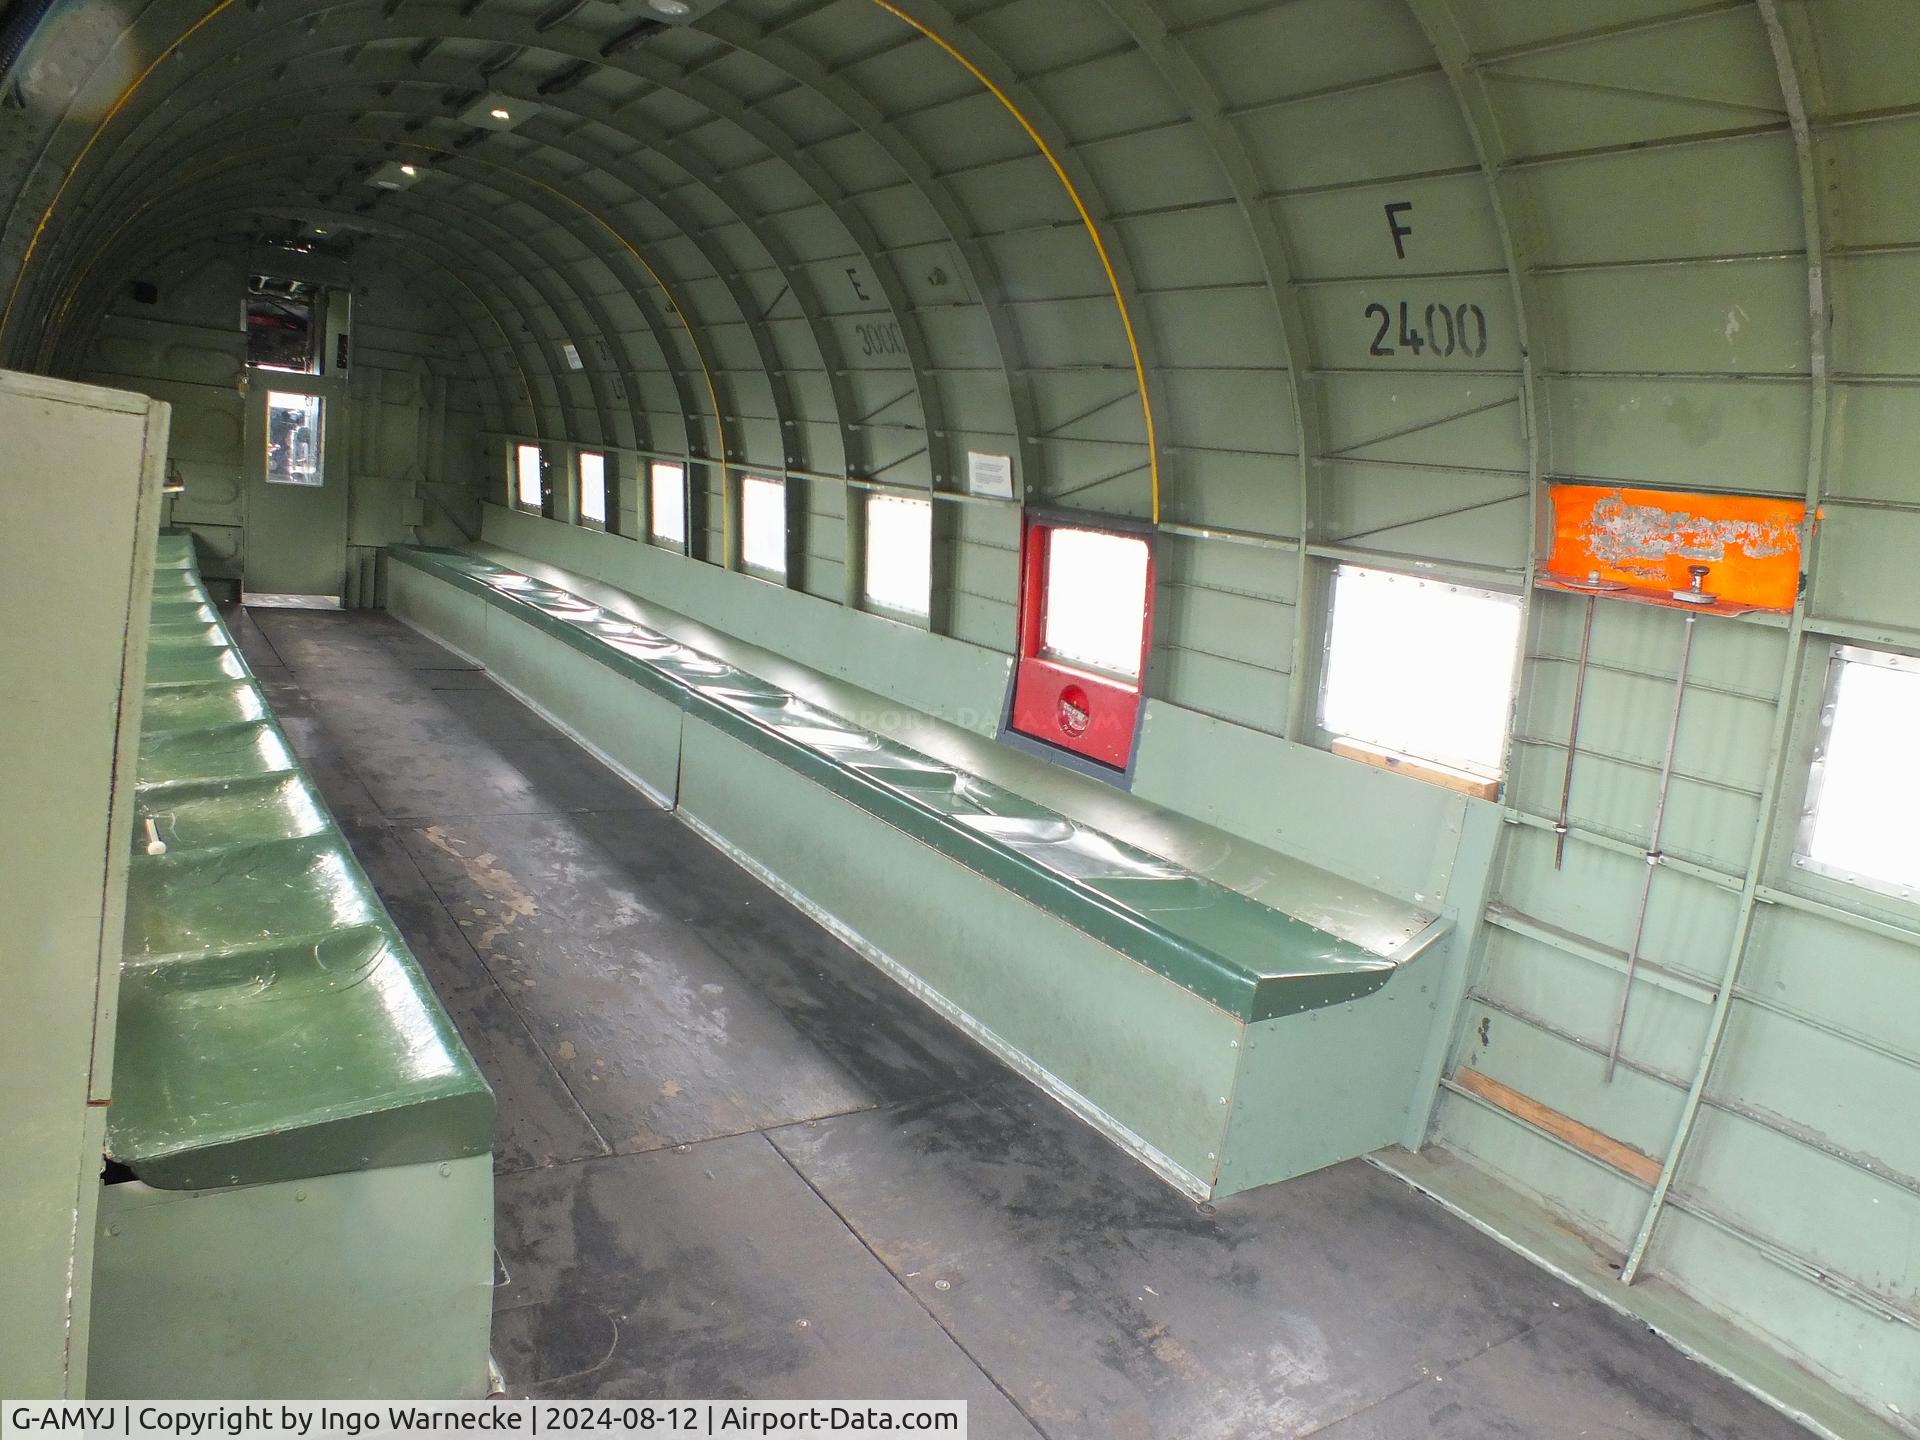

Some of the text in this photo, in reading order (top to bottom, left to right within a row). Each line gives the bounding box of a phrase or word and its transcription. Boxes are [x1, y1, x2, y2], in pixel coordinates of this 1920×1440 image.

[1384, 202, 1412, 259] F
[846, 268, 870, 301] E
[1364, 302, 1487, 358] 2400
